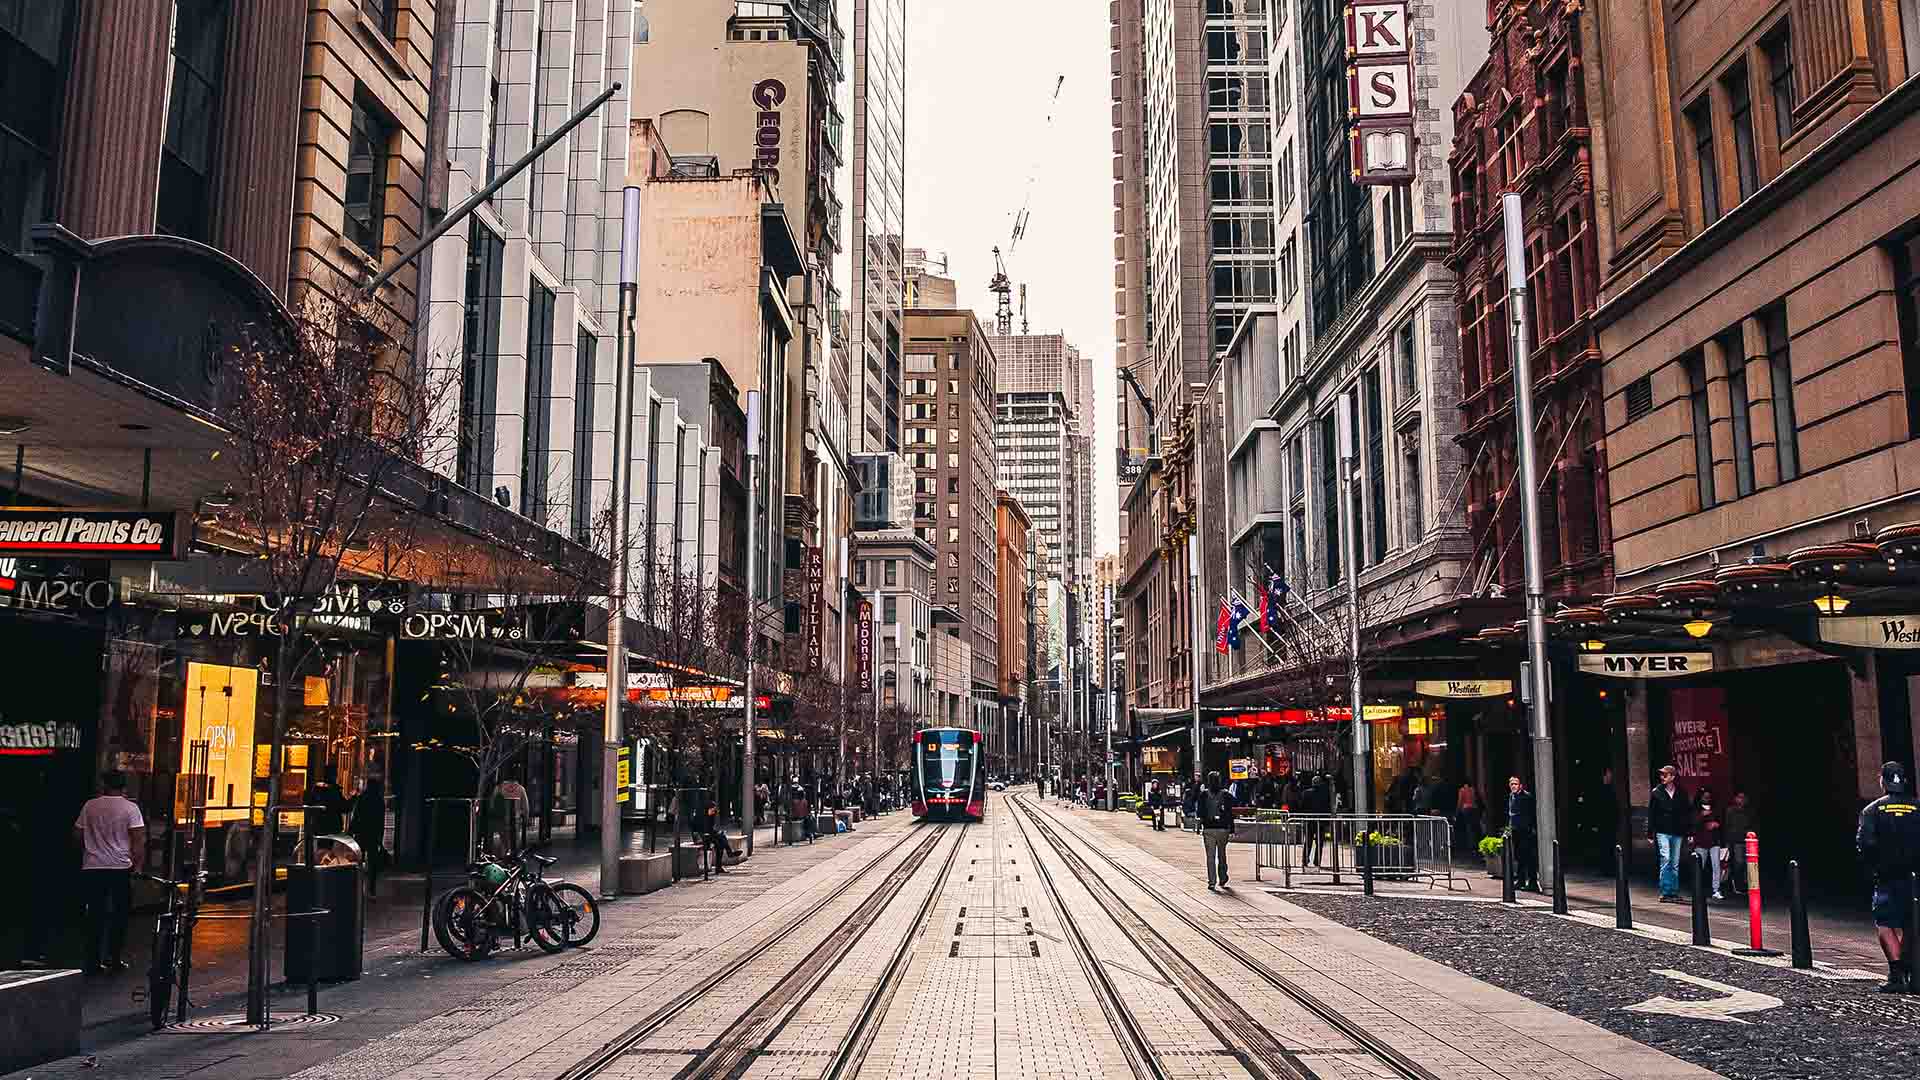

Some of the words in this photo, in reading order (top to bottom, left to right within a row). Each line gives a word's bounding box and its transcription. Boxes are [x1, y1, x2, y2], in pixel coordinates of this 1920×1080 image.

[65, 518, 130, 543] Pants
[131, 518, 164, 544] Co.
[405, 613, 486, 639] OPSM
[1604, 656, 1689, 672] MYER
[1448, 681, 1482, 694] Westfield
